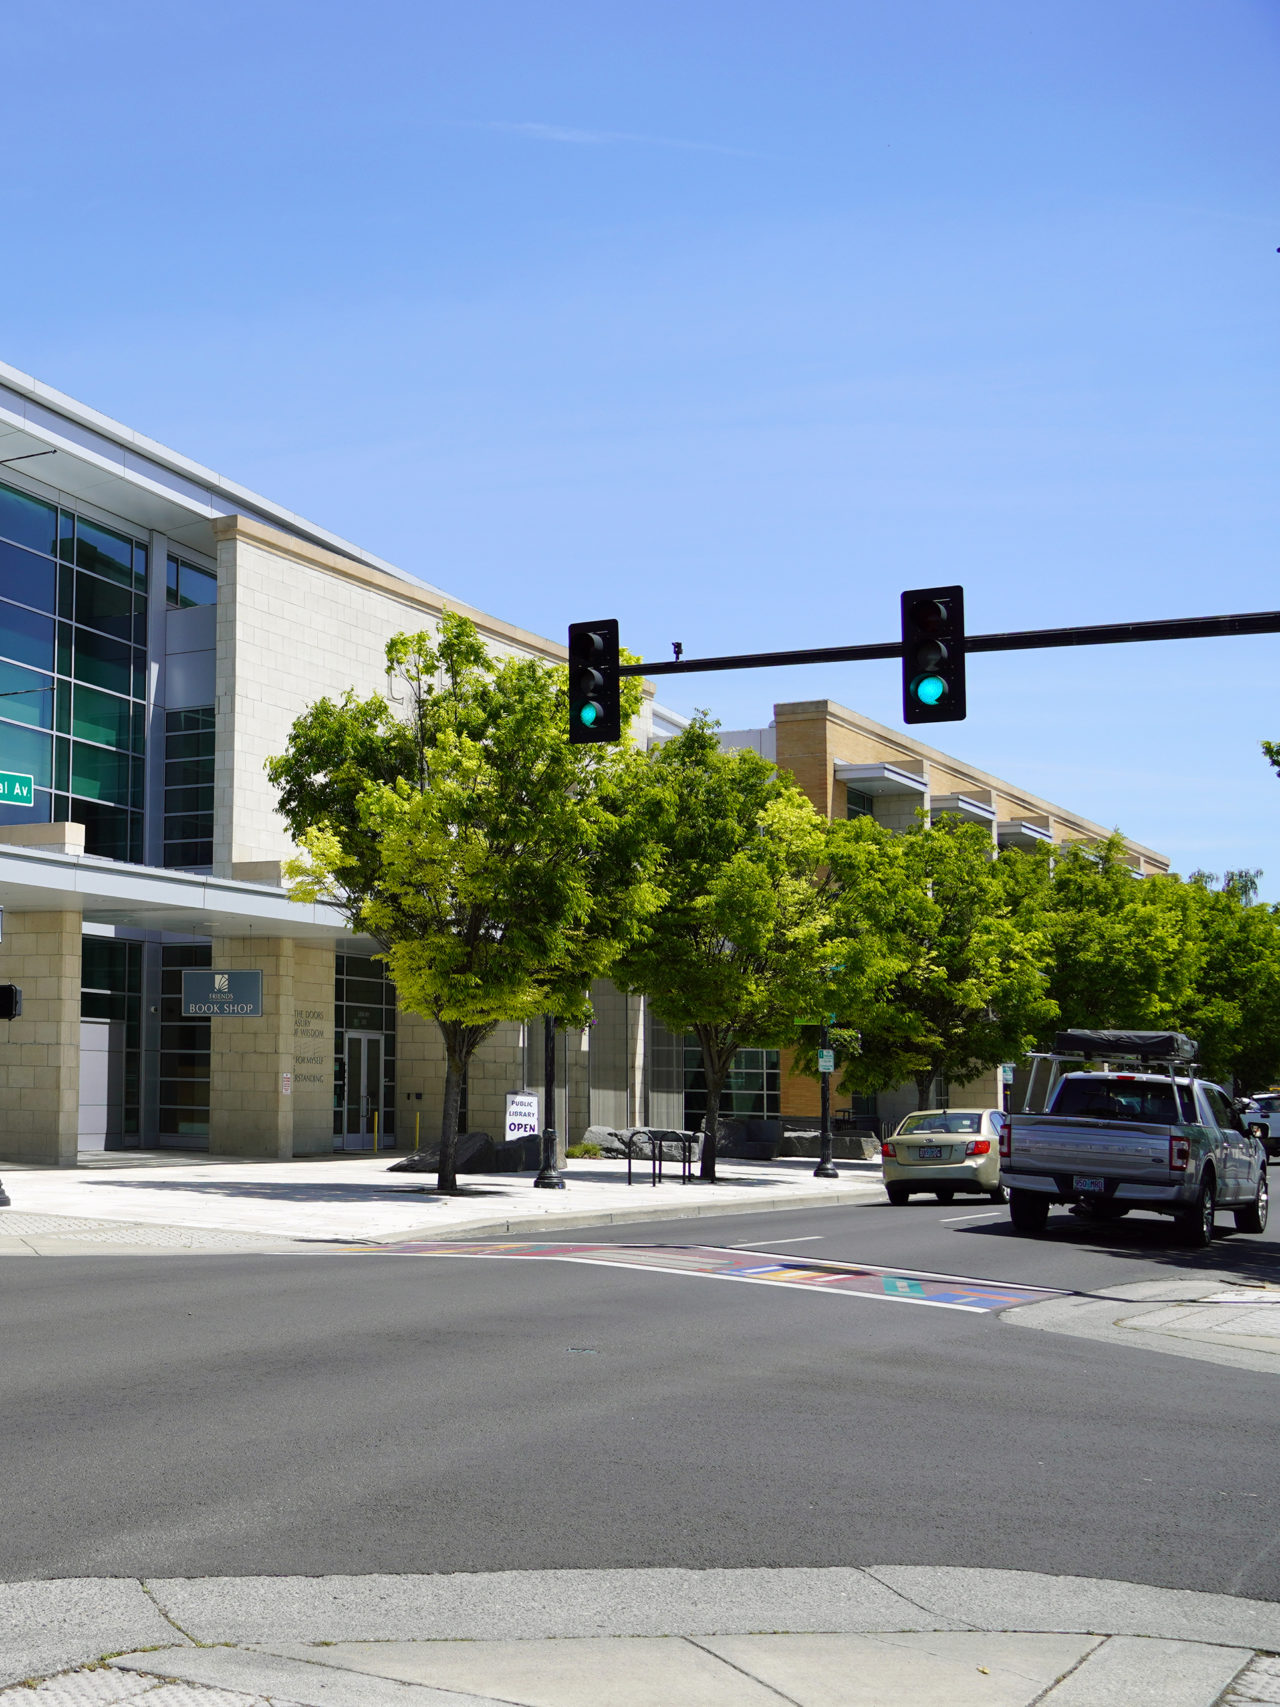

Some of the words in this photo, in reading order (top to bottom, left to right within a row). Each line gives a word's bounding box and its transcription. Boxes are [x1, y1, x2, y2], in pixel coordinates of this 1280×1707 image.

[13, 782, 30, 797] Av.
[189, 1003, 220, 1014] BOOK
[223, 1003, 253, 1014] SHOP
[305, 1010, 324, 1020] DOORS
[301, 1028, 324, 1038] WISDOM
[511, 1100, 533, 1108] PUBLIC
[508, 1122, 536, 1133] OPEN
